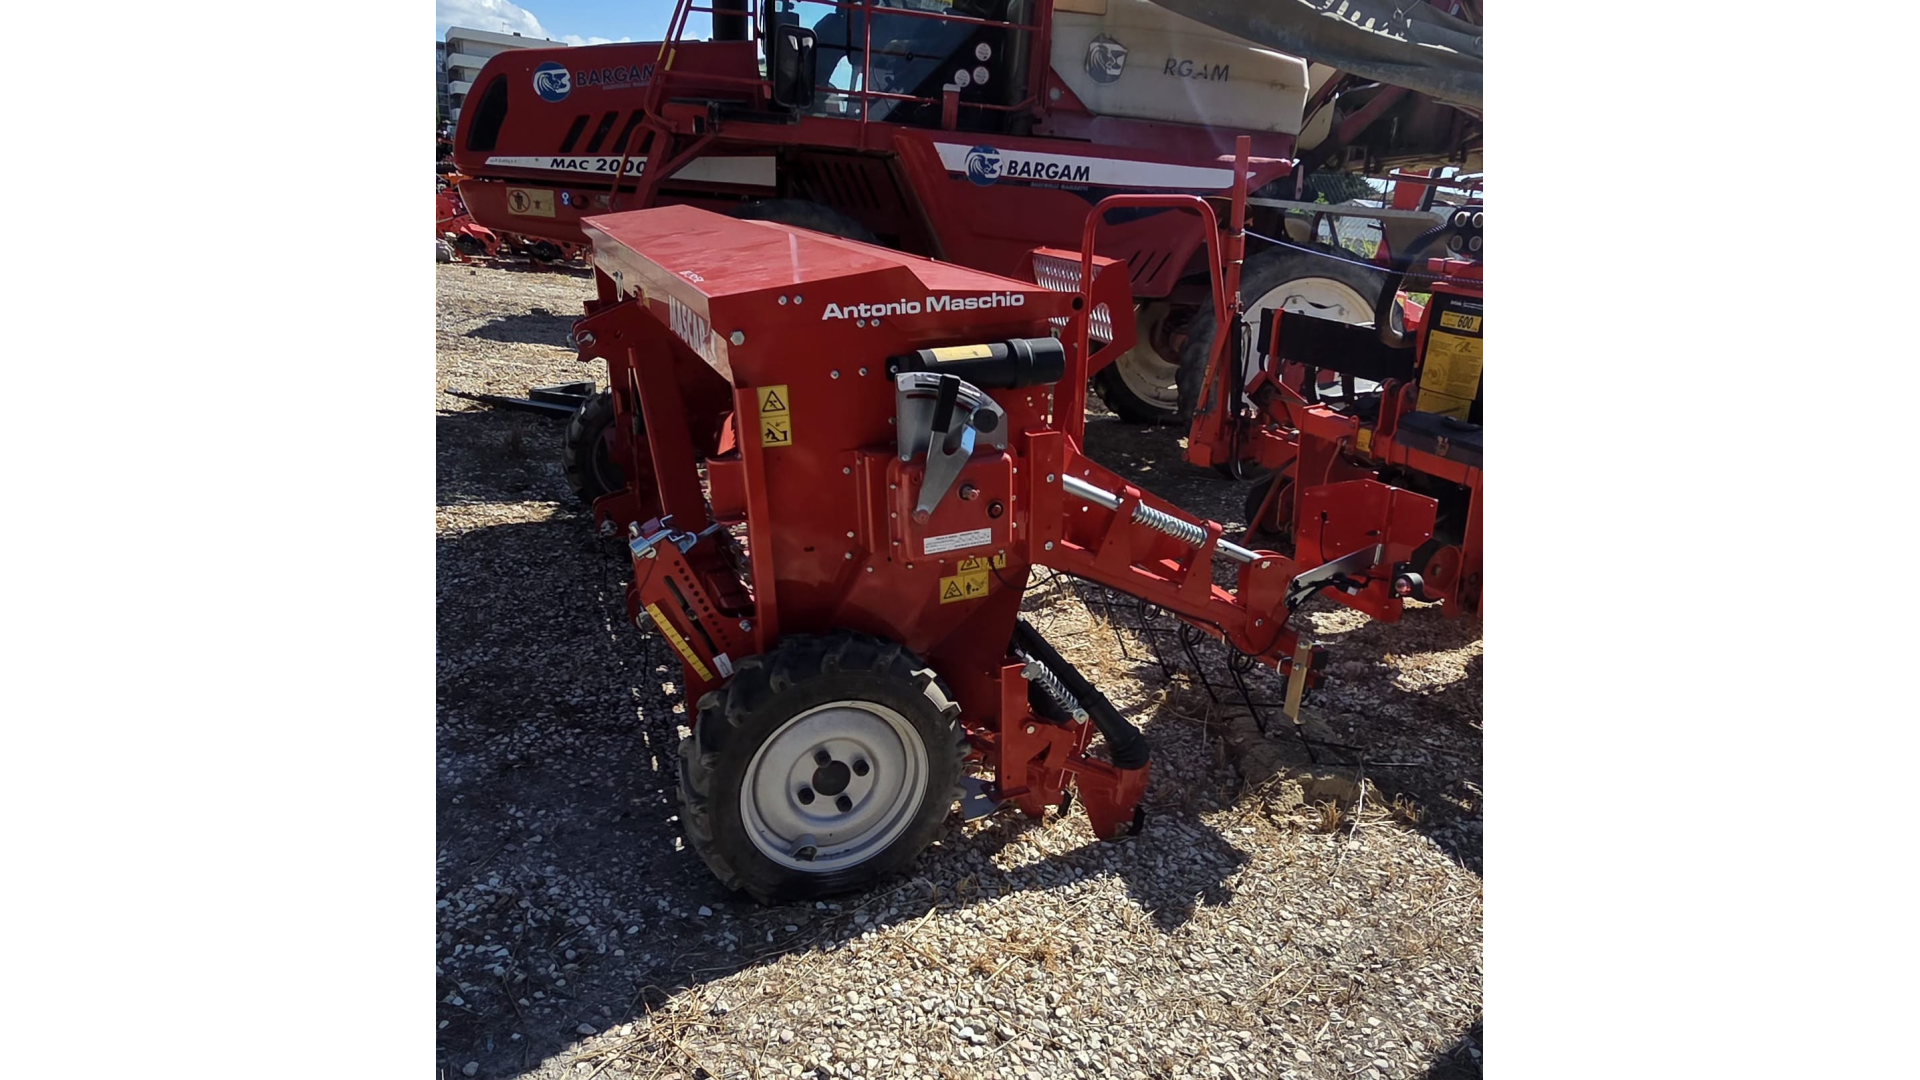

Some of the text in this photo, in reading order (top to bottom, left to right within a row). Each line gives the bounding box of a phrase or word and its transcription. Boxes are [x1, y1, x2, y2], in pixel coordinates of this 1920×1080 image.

[550, 158, 589, 171] MAC
[1006, 159, 1090, 182] BARGAM
[821, 291, 1025, 321] Antonio Maschio
[1457, 315, 1473, 329] 600
